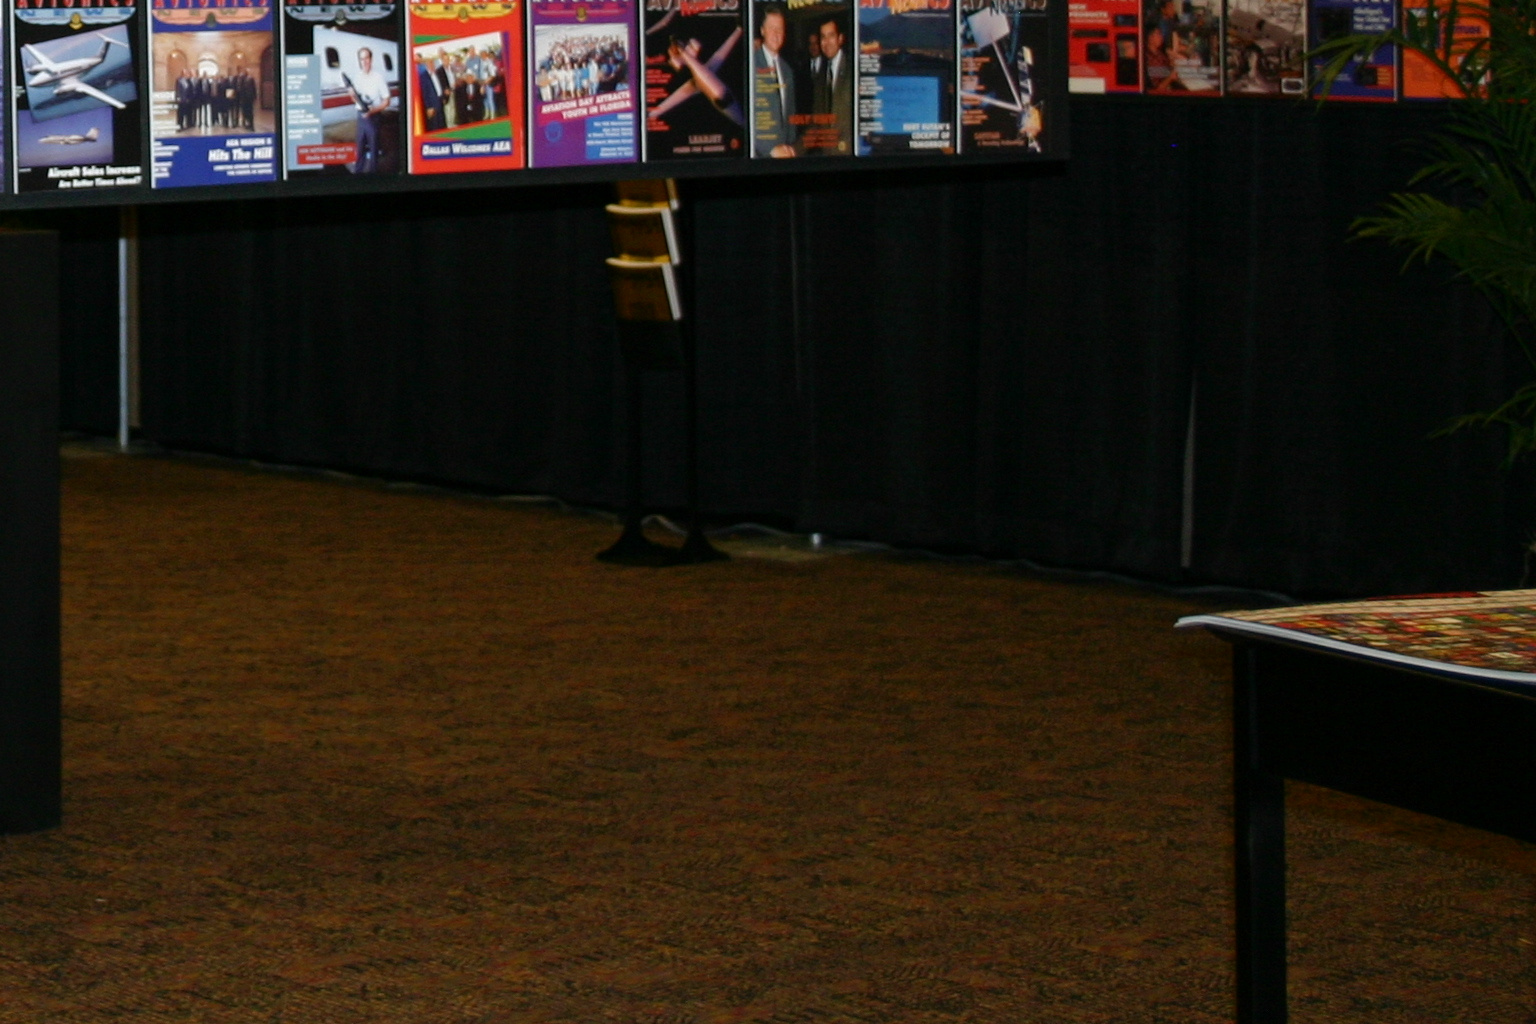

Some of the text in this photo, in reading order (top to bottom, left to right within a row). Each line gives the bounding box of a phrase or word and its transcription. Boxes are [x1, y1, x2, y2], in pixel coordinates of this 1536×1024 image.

[541, 90, 630, 114] AVIATION DAY ATTRACTS
[562, 108, 588, 120] YOUTH
[599, 100, 632, 114] FLORIDA
[208, 146, 273, 162] Hits The Hill
[492, 141, 511, 152] AEA
[47, 165, 141, 179] Aircraft Sales Increase
[72, 178, 93, 188] Better
[95, 177, 114, 187] Times
